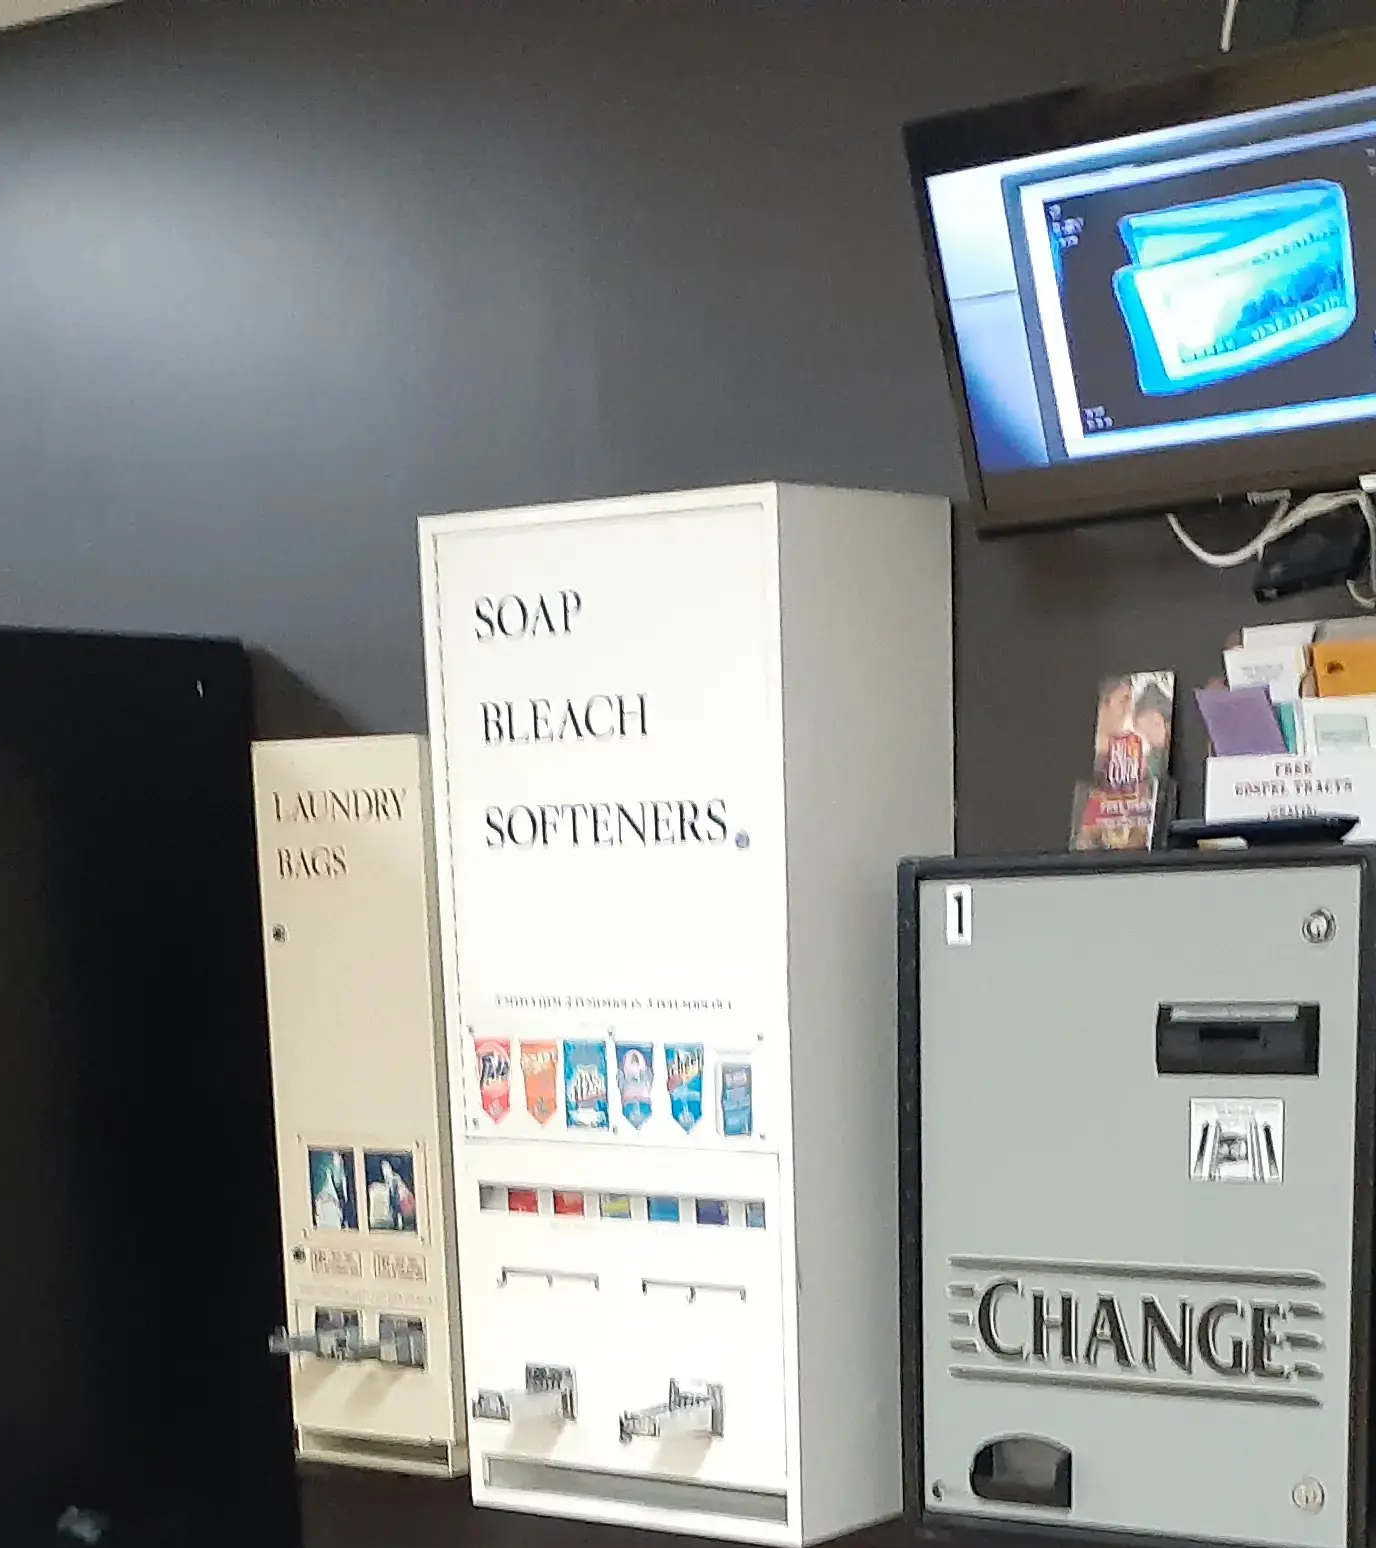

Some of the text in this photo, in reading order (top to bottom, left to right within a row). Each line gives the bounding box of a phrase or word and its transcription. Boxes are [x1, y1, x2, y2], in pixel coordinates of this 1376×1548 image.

[474, 588, 582, 642] SOAP
[480, 692, 648, 745] BLEACH
[273, 787, 407, 823] LAUNDRY
[485, 797, 728, 850] SOFTENERS
[277, 845, 348, 880] BAGS
[977, 1276, 1287, 1378] CHANGE
